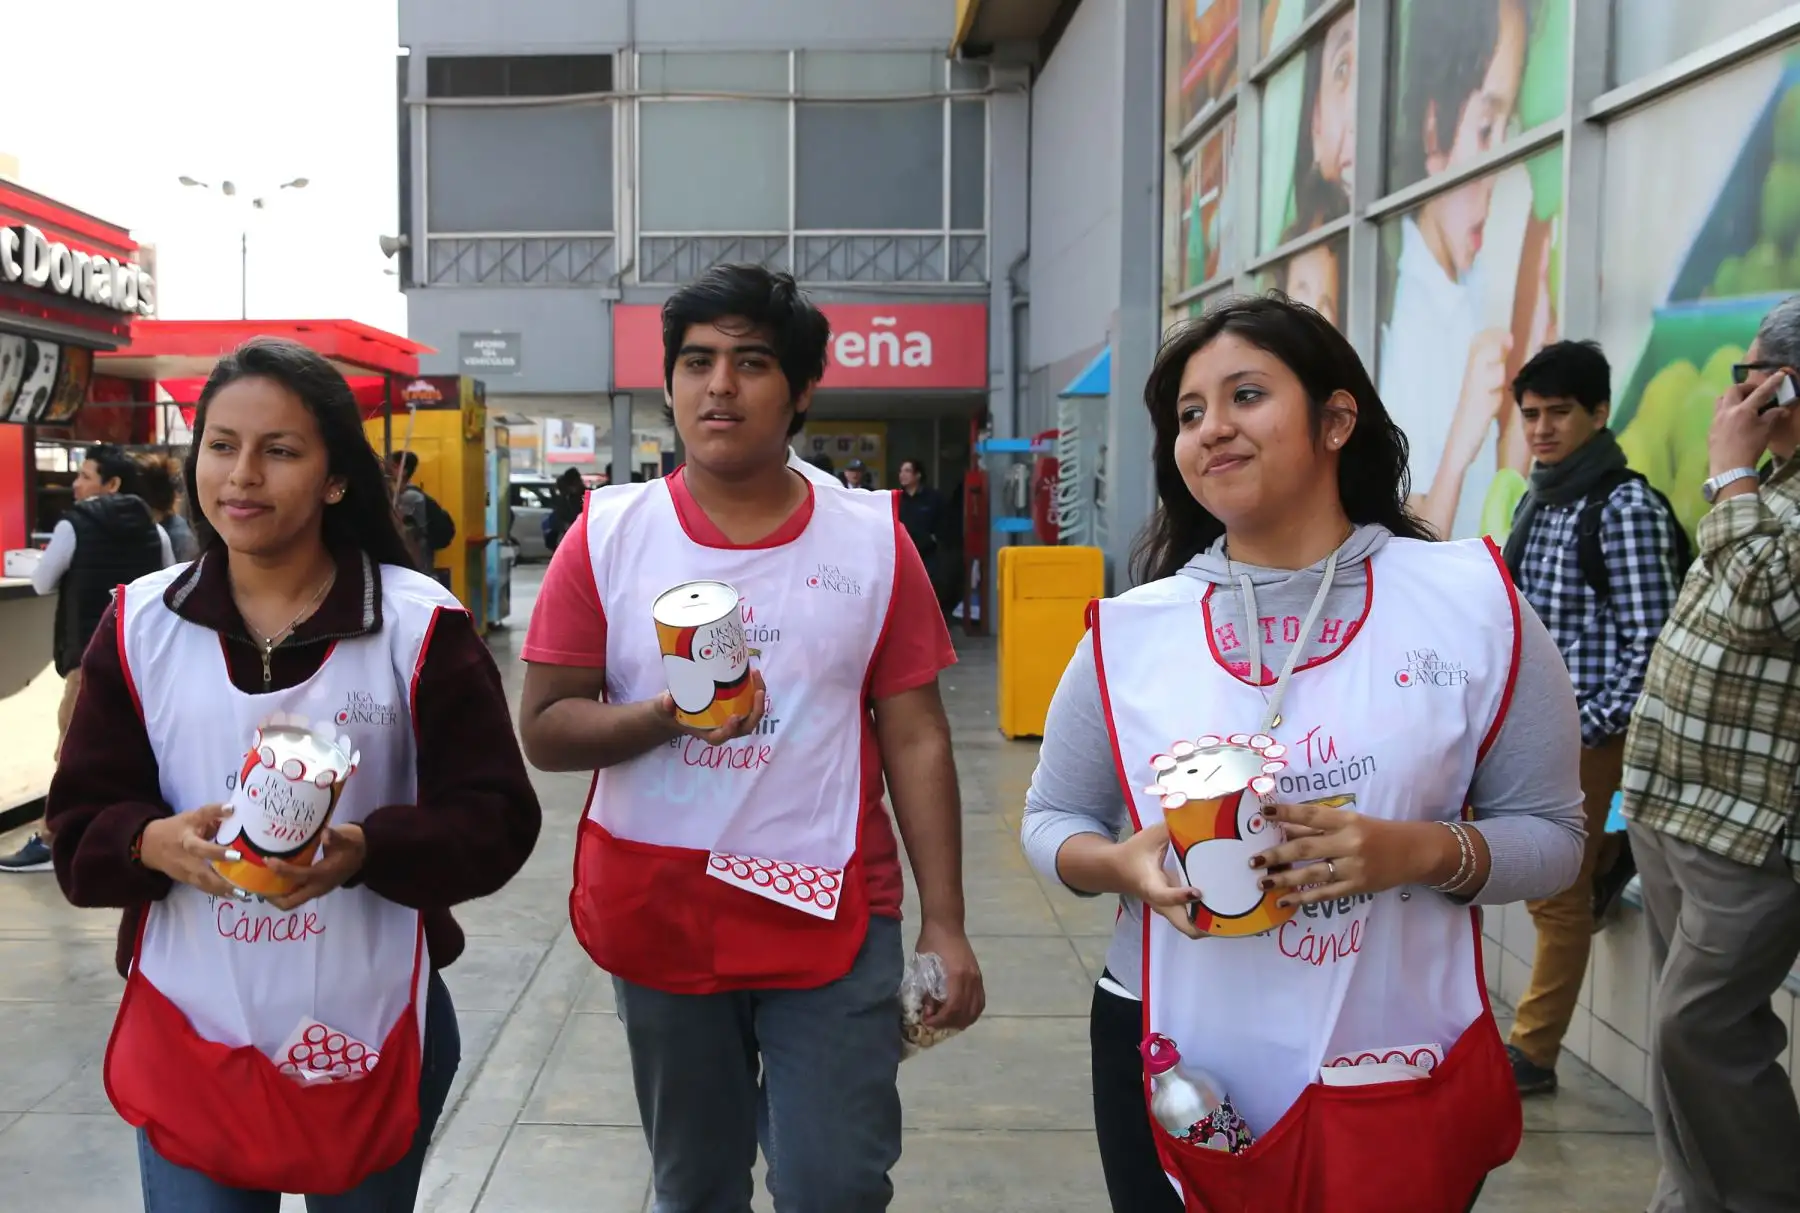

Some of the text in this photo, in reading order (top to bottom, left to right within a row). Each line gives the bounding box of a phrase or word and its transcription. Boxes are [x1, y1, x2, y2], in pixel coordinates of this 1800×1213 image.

[829, 316, 933, 368] eña
[730, 644, 746, 670] 201
[1406, 648, 1440, 663] LIGA
[1408, 660, 1455, 671] CONTRA
[346, 690, 374, 703] LIGA
[265, 774, 294, 798] LIGA
[1278, 918, 1362, 966] Cánce
